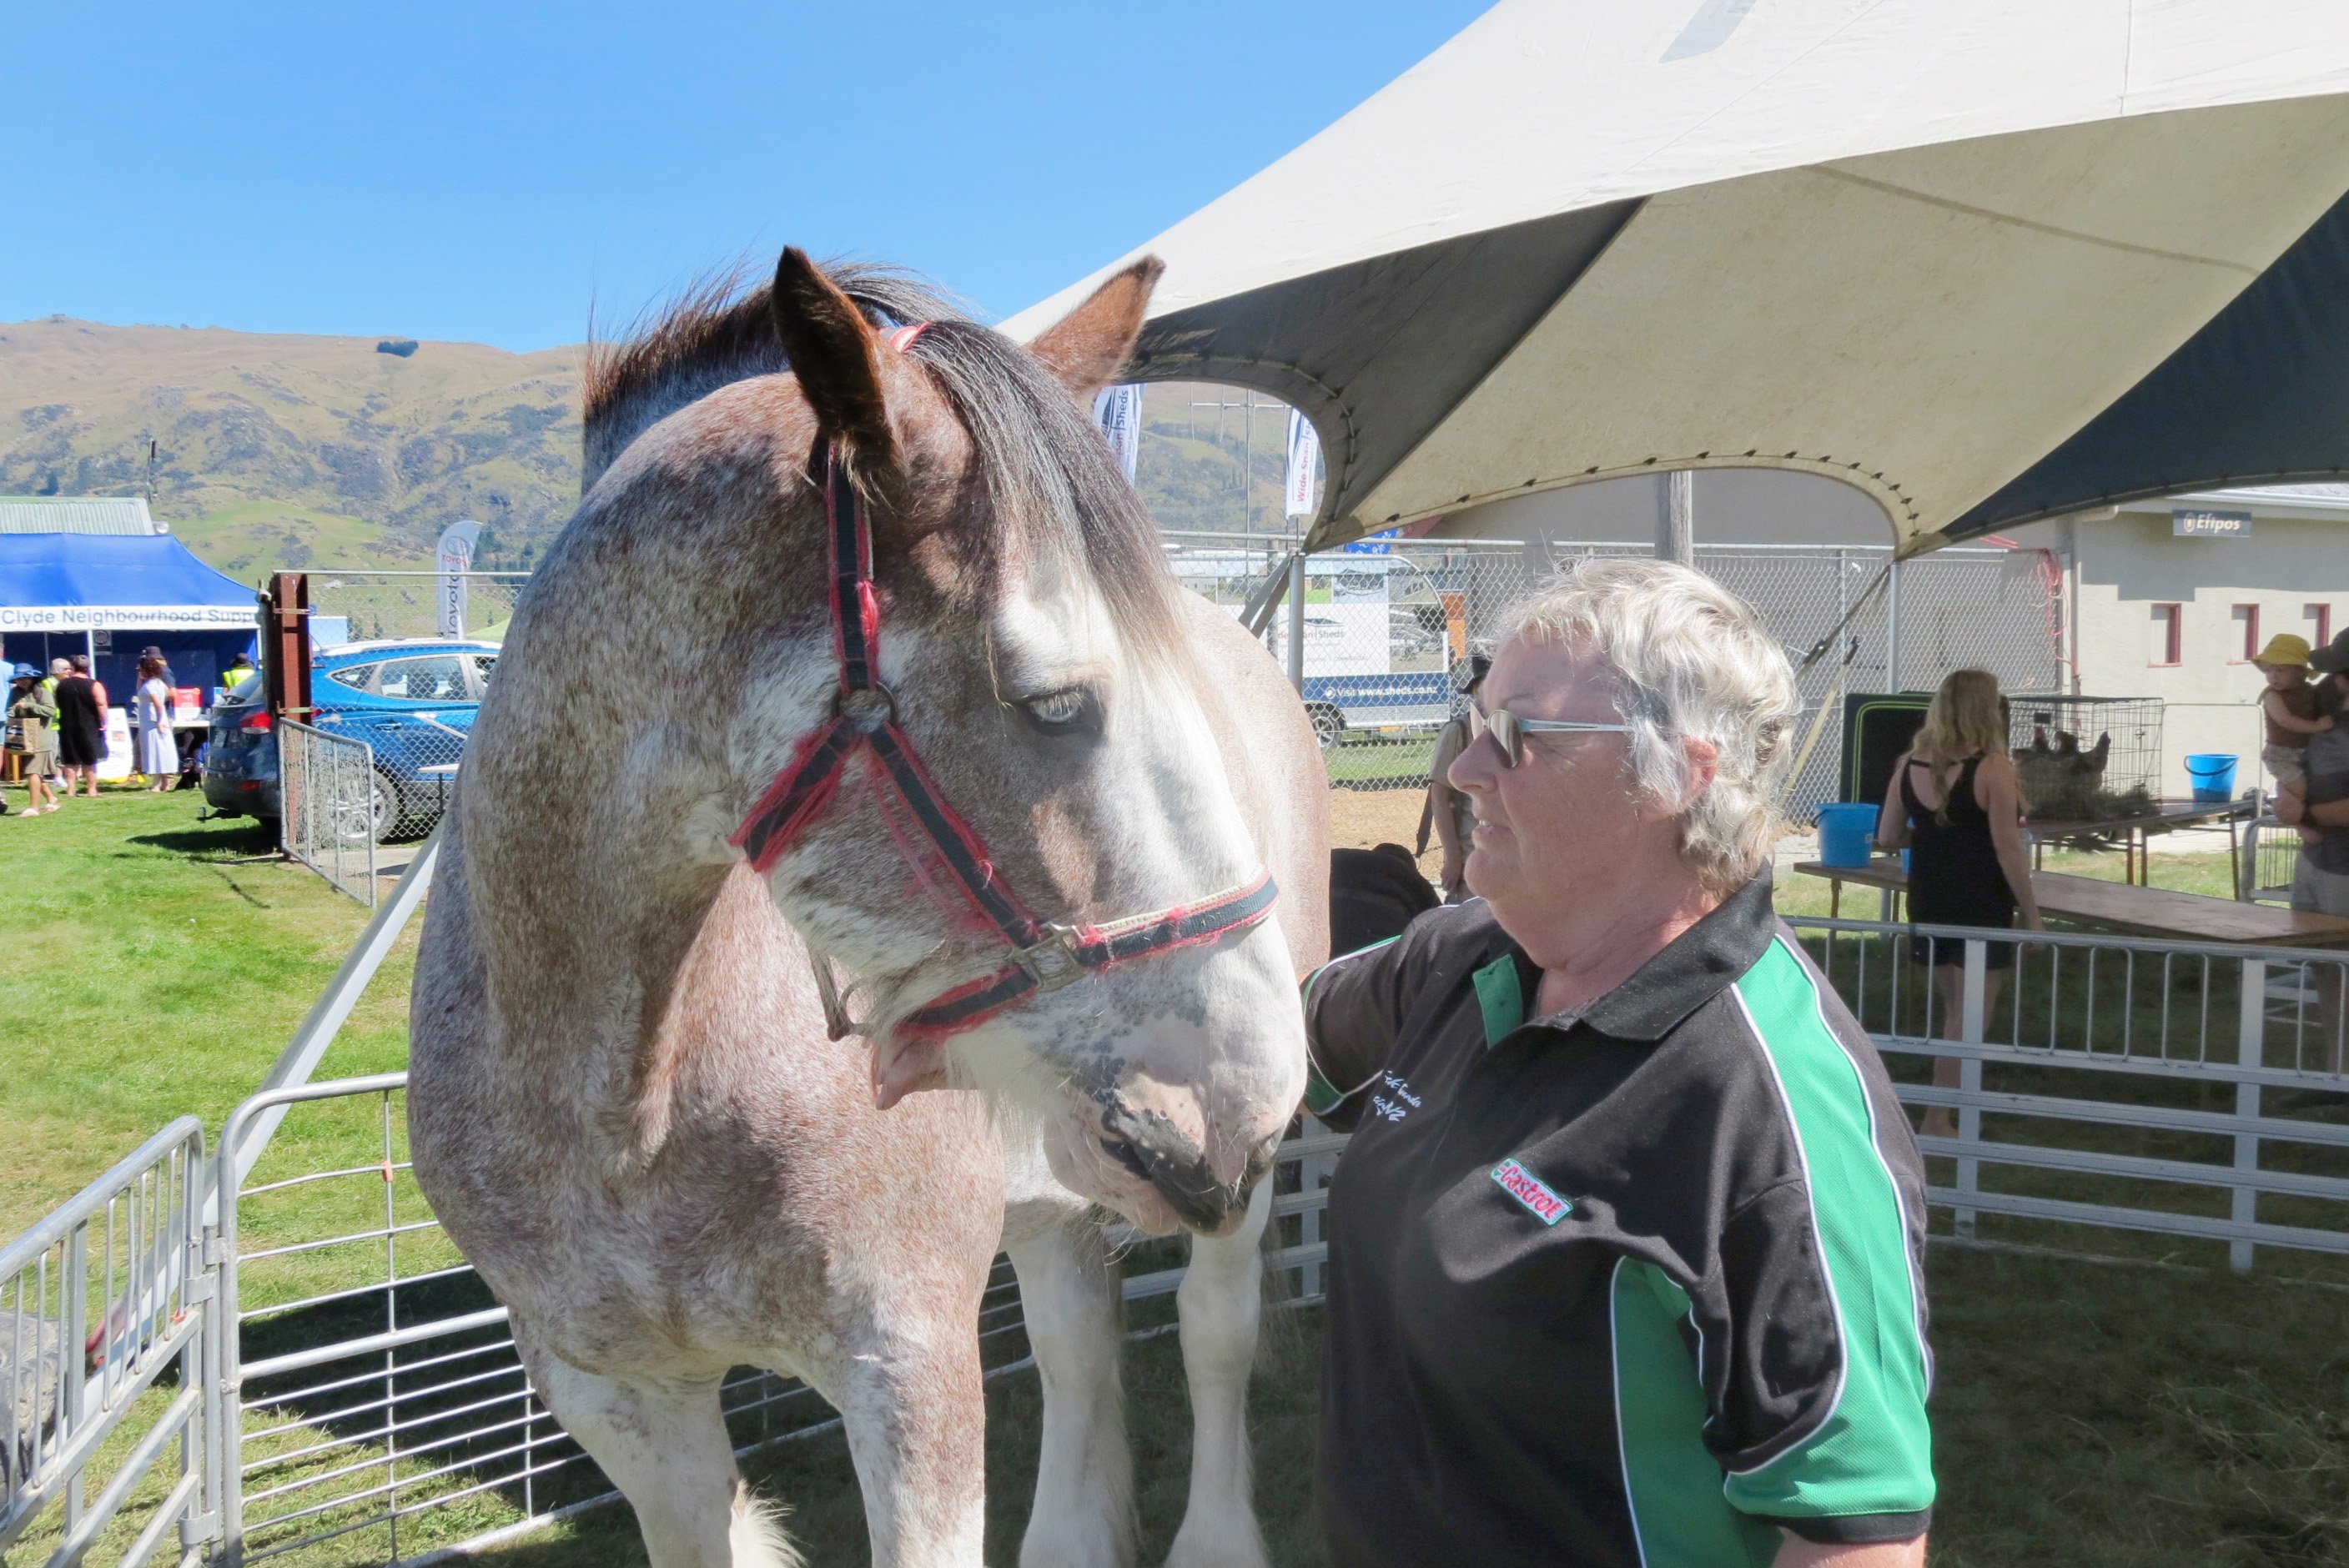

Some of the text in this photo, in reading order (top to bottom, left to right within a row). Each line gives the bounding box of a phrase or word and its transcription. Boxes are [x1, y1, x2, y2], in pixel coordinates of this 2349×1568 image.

[1116, 389, 1129, 426] Sheds
[1297, 475, 1307, 502] Wide
[2196, 512, 2241, 534] Eftpos
[2, 609, 254, 627] Clyde Neighbourhood Supp
[1318, 630, 1345, 639] Sheds
[1337, 686, 1438, 697] Visit www.sheds.co.nz
[1501, 1166, 1562, 1219] Castrol
